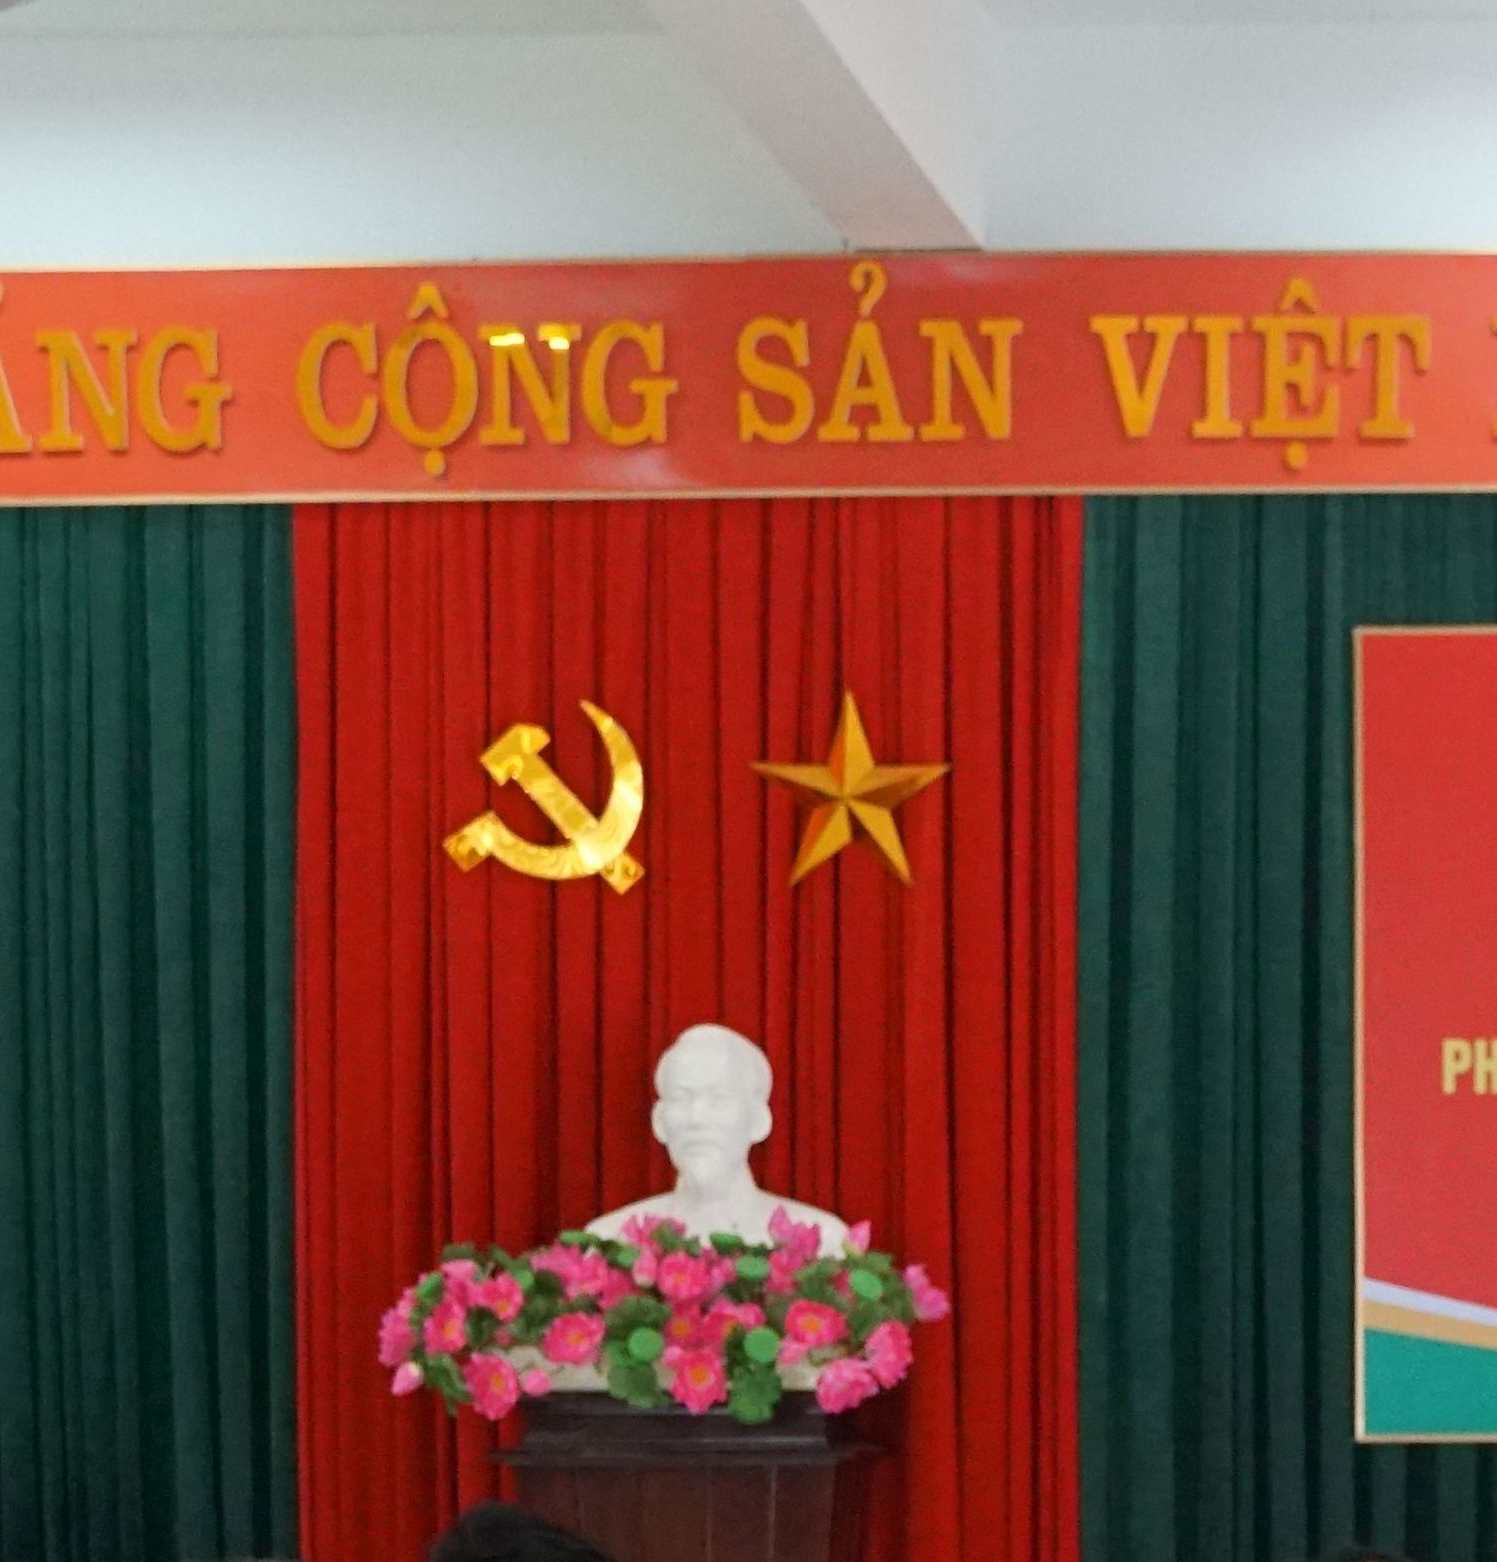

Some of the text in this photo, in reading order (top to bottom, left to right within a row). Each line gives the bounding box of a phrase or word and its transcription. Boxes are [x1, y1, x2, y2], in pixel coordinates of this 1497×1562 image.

[296, 282, 680, 478] CỘNG
[736, 260, 1024, 444] SẢN
[1090, 276, 1432, 472] VIỆT
